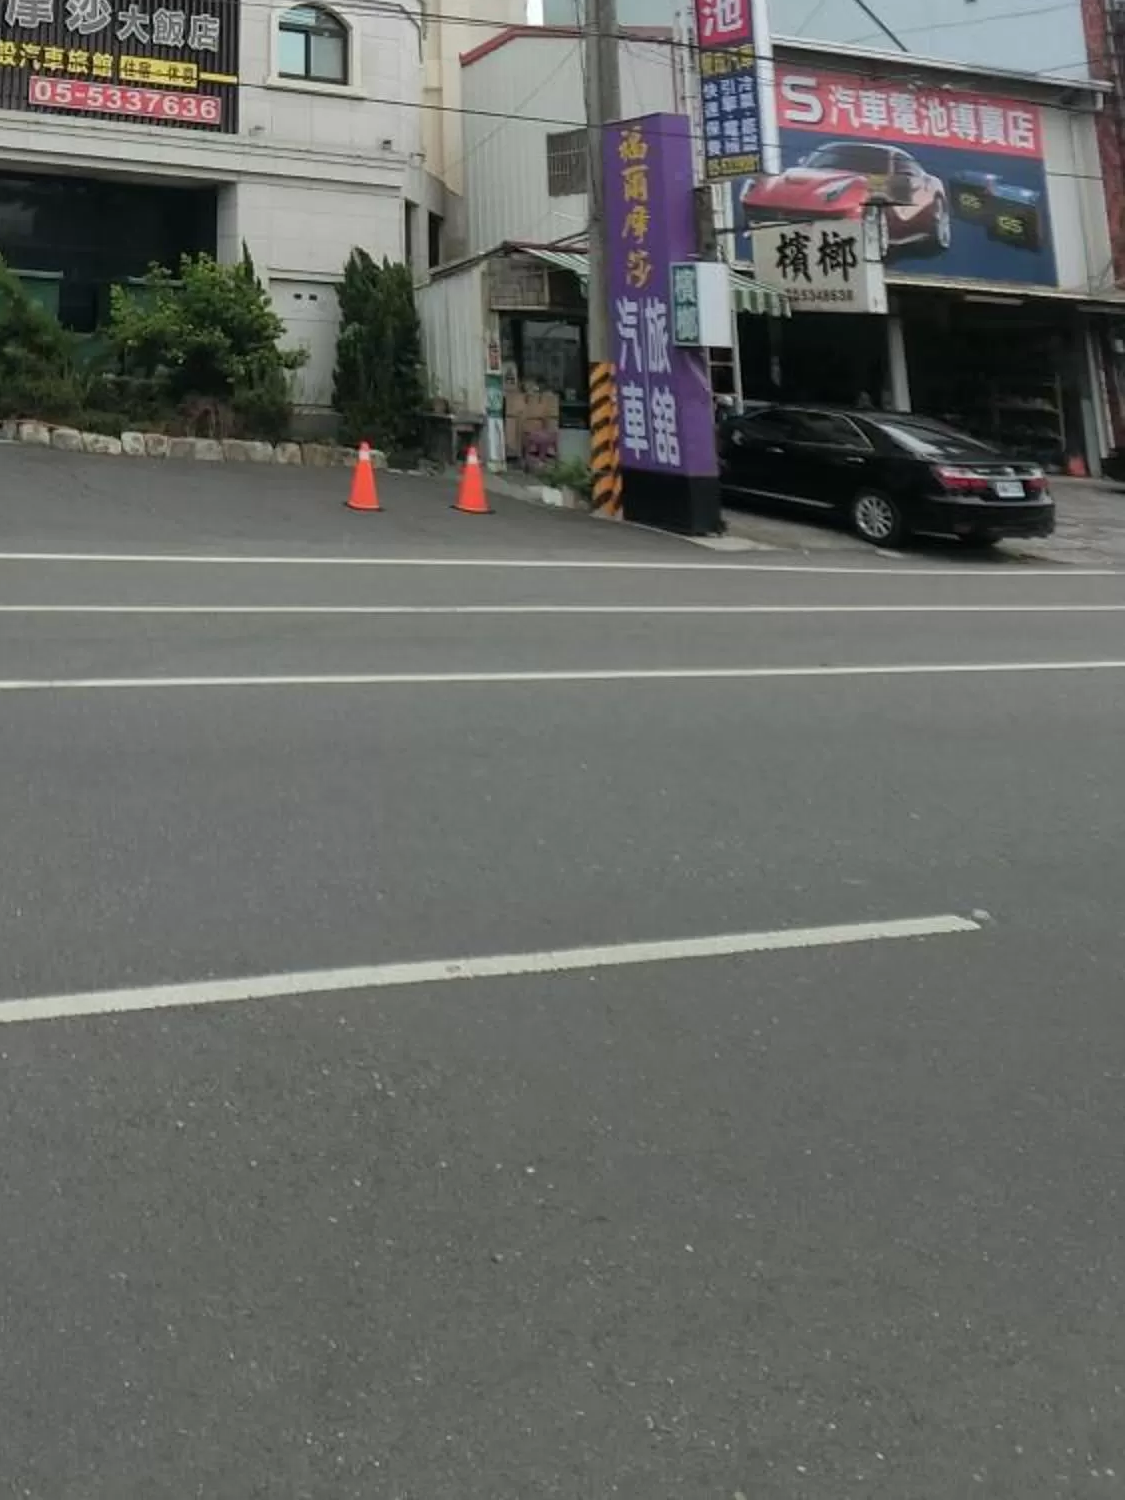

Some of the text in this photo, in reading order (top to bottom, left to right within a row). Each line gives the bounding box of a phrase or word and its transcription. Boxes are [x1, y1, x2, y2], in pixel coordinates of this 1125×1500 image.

[33, 80, 217, 120] 05-5337636
[828, 84, 1037, 150] 汽車電池專賣店
[618, 125, 652, 288] 福爾摩莎
[776, 230, 858, 282] 檳榔
[616, 296, 681, 466] 汽車 旅館
